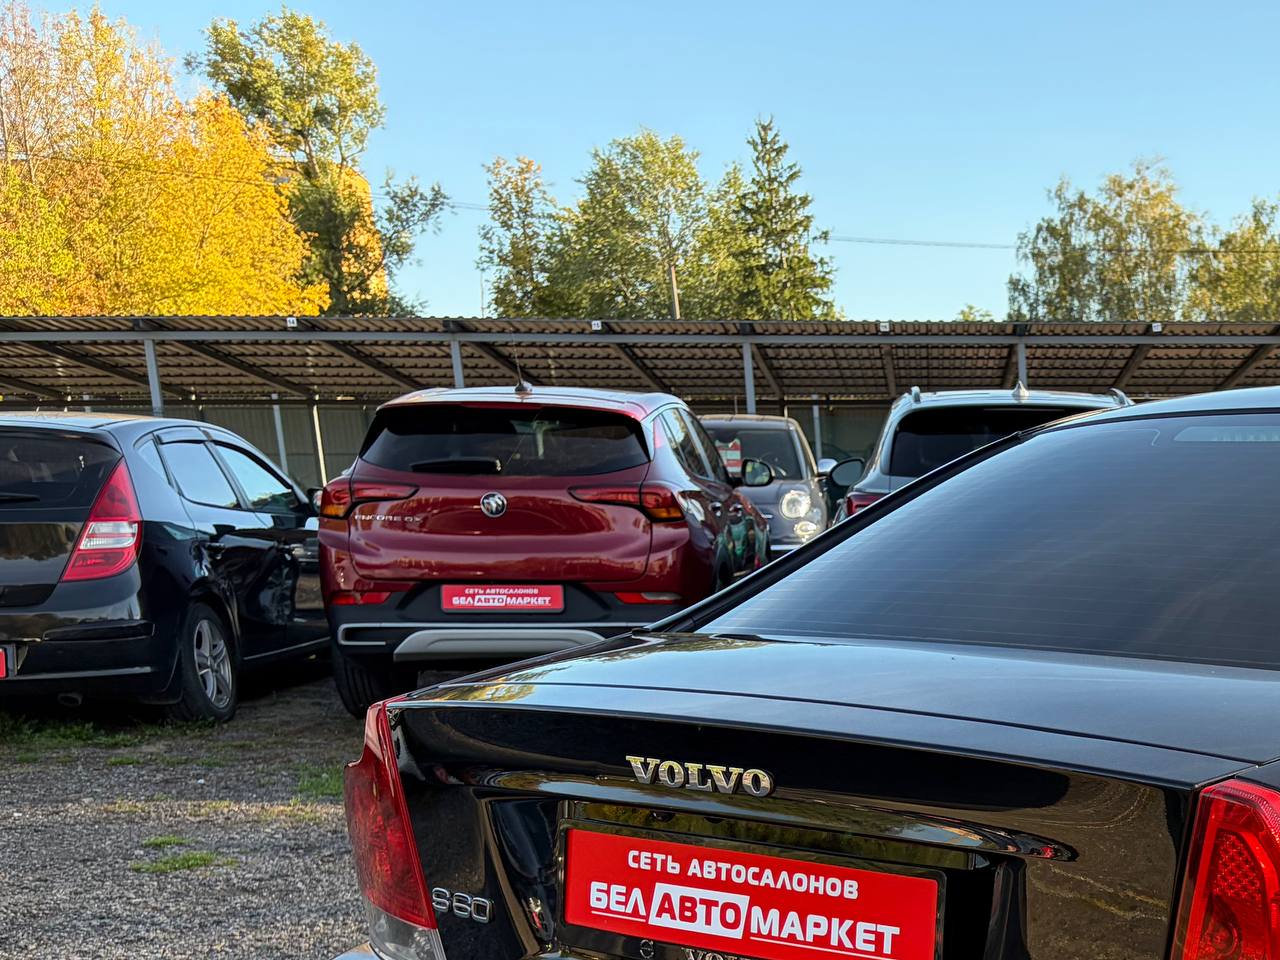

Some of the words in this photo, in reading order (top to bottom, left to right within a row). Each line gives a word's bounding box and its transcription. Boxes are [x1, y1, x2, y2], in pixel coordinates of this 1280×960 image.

[626, 755, 773, 798] VOLVO
[628, 849, 681, 874] СЕТЬ
[687, 858, 859, 900] АВТОСАЛОНОВ
[432, 887, 490, 924] S60
